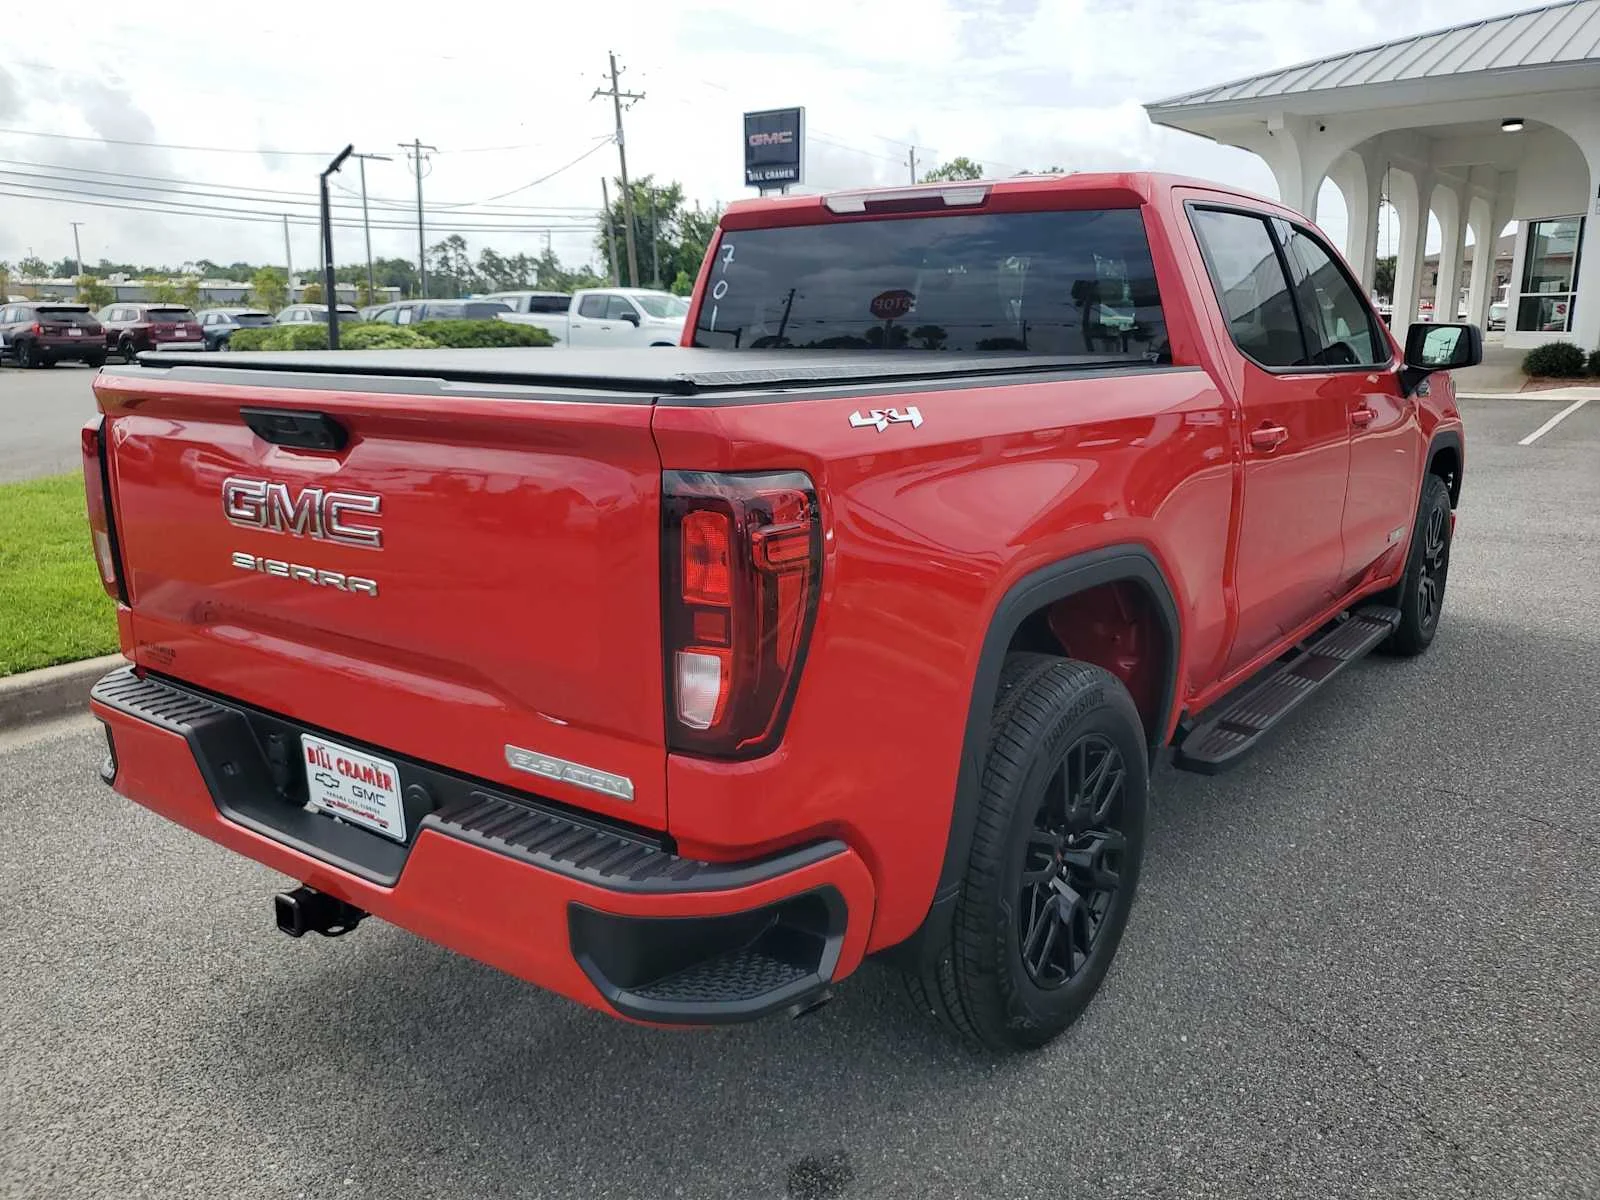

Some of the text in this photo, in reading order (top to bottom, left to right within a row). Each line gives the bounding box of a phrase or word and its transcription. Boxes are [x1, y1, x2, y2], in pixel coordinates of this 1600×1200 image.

[749, 131, 793, 146] GMC
[765, 169, 795, 180] CRAMER
[222, 477, 382, 549] GMC
[231, 551, 378, 597] SIERRA
[306, 746, 394, 792] BILL CRAMER
[351, 784, 387, 808] GMC
